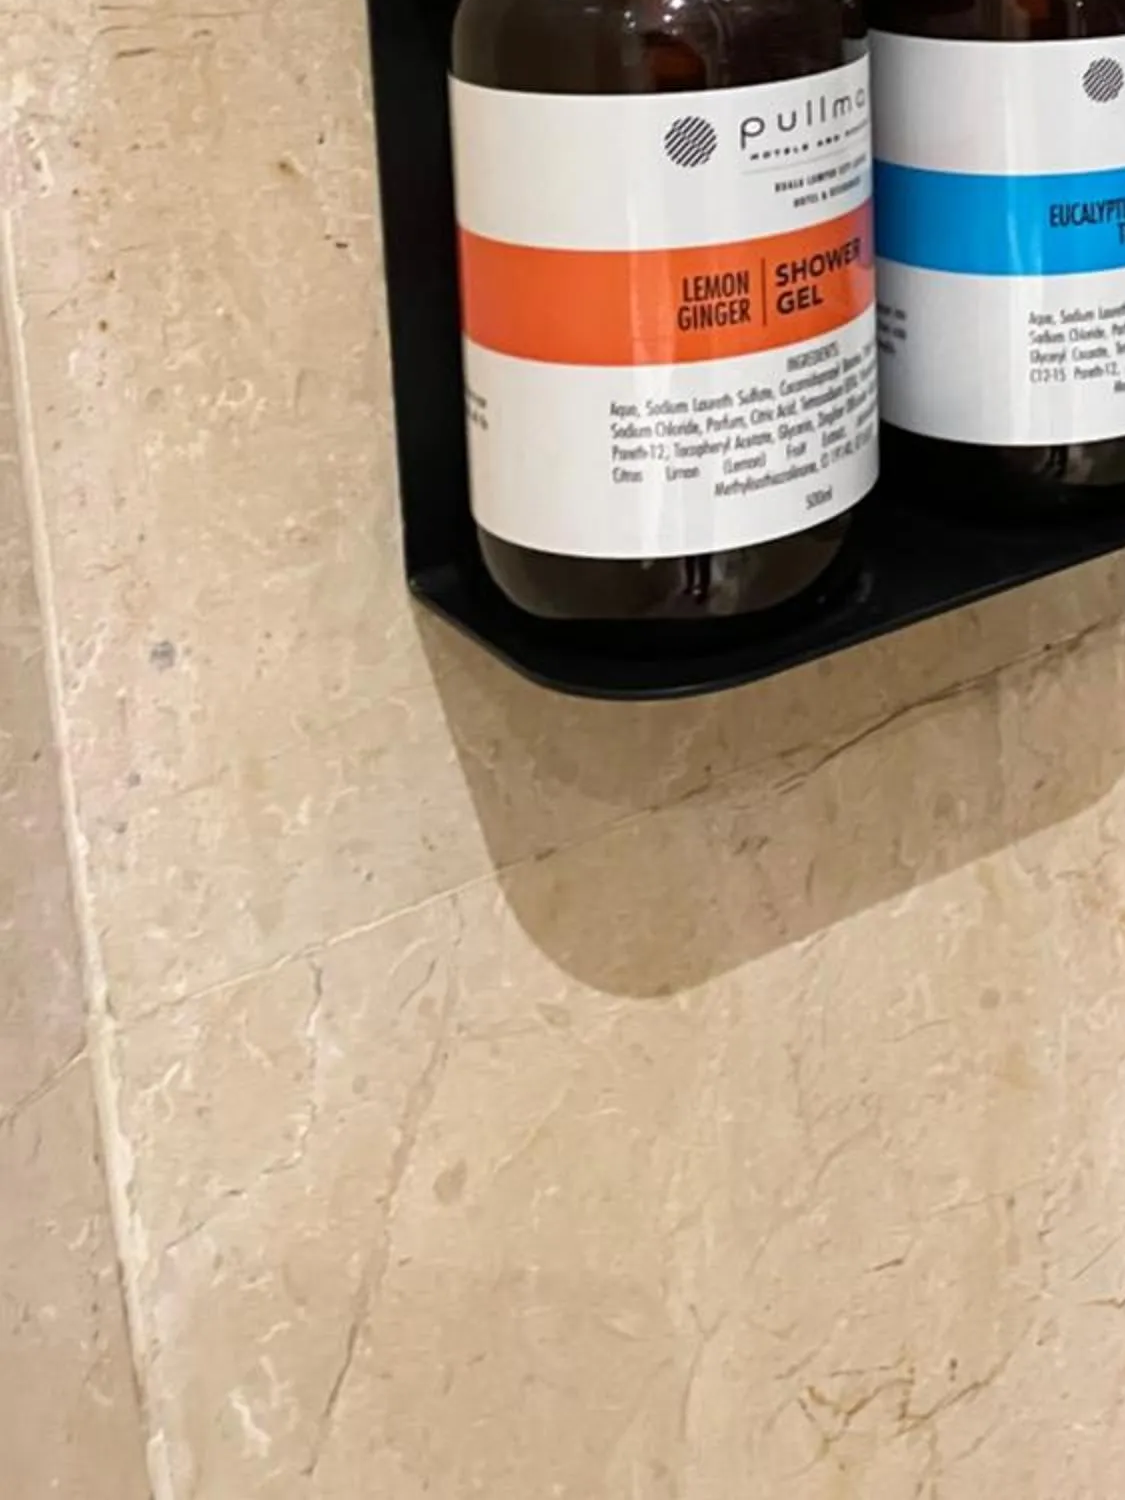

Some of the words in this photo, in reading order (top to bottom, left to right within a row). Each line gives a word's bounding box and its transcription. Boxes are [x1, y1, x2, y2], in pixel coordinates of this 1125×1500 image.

[775, 237, 861, 287] SHOWER
[682, 270, 750, 303] LEMON
[776, 284, 824, 315] GEL
[677, 299, 751, 331] GINGER
[645, 399, 689, 417] Sodium
[610, 422, 653, 439] Sodium
